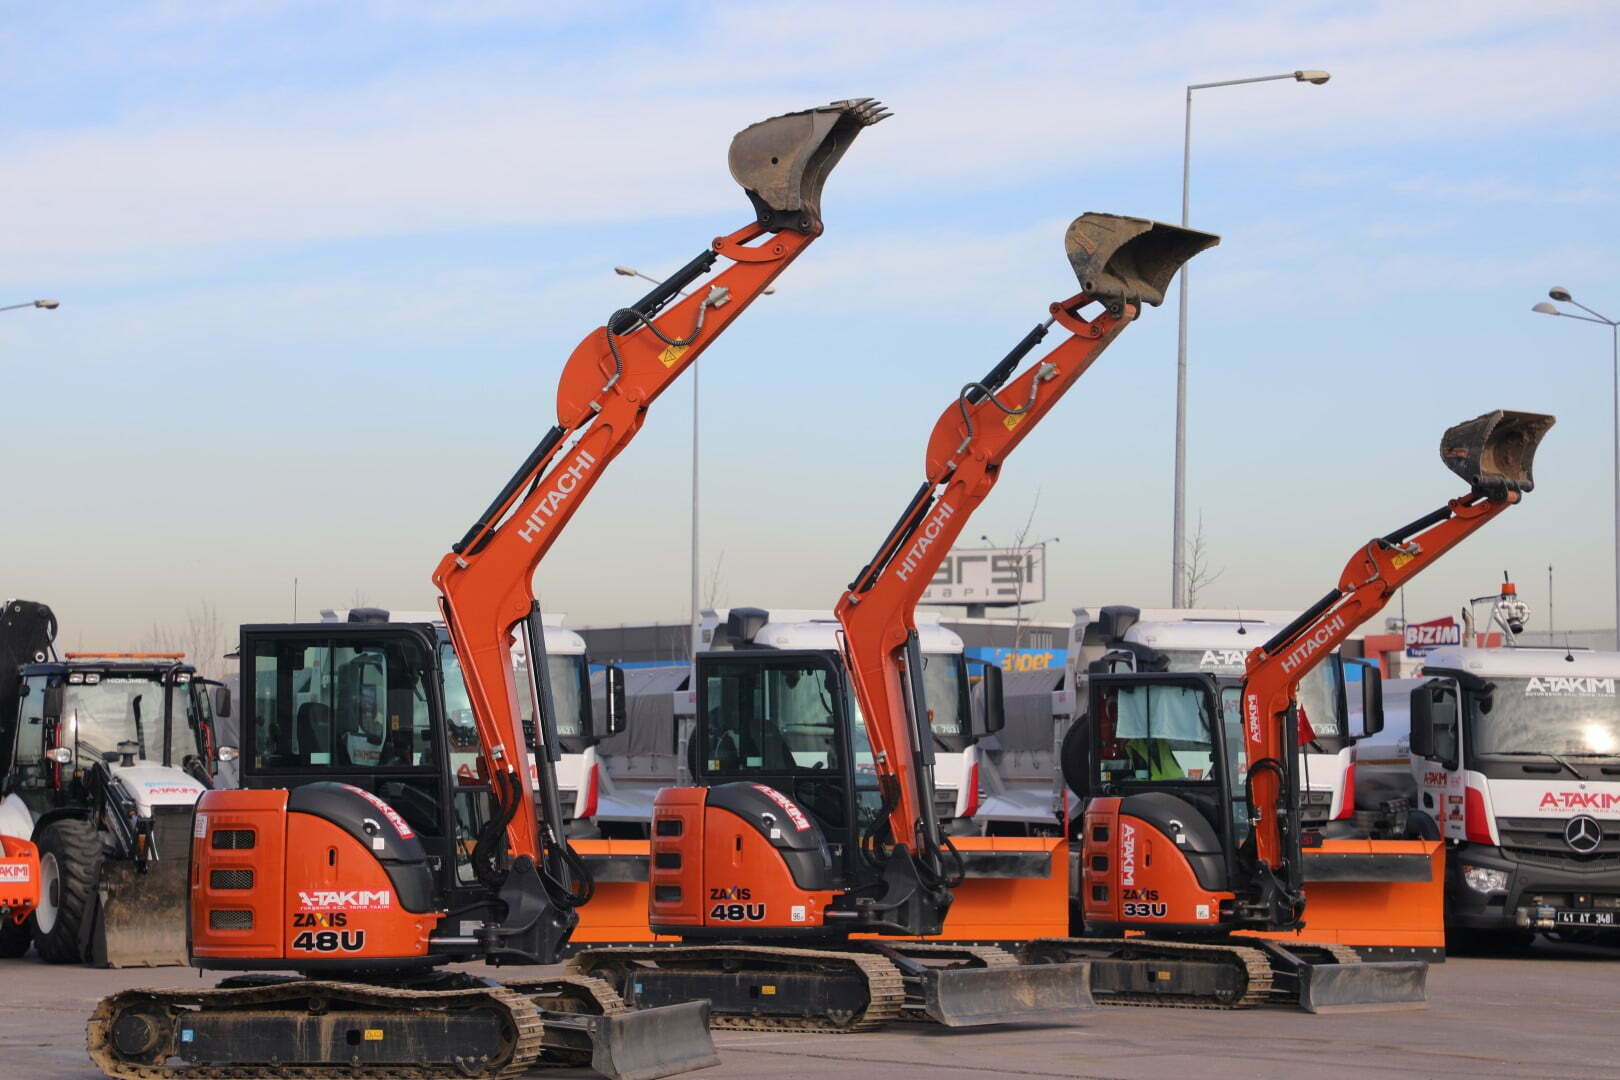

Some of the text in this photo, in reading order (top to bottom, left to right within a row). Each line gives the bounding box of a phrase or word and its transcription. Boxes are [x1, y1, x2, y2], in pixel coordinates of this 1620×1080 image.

[517, 449, 596, 543] HITACHI
[896, 502, 954, 582] HITACHI
[1281, 614, 1345, 673] HITACHI
[709, 903, 766, 922] 48U
[1123, 903, 1167, 917] 33U
[292, 930, 366, 953] 48U
